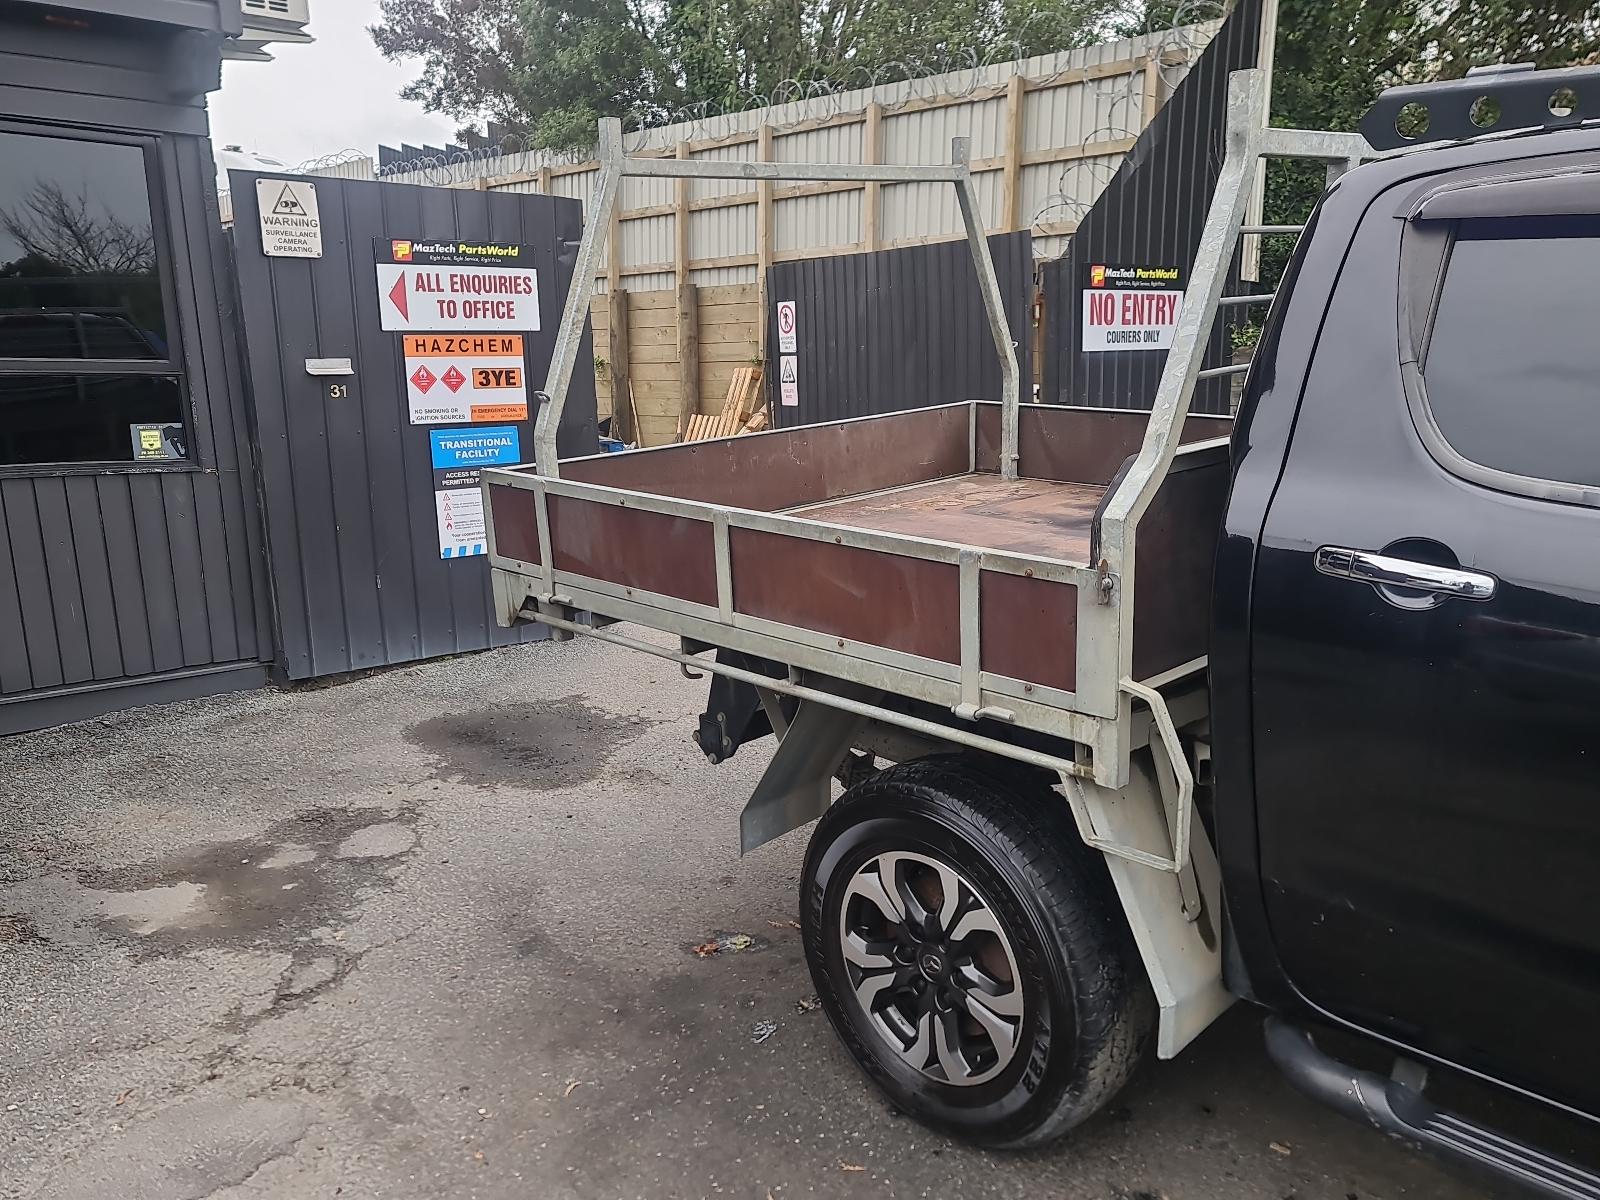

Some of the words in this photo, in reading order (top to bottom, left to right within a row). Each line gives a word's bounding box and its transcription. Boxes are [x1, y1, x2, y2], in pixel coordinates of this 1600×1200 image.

[263, 216, 318, 228] WARNING
[265, 229, 318, 238] SURVEILLANCE
[273, 245, 313, 253] OPERATING
[413, 243, 456, 254] MazTech
[458, 244, 519, 257] PartsWorld
[1105, 268, 1135, 278] MazTech
[1136, 268, 1178, 279] PartsWorld
[415, 272, 444, 292] ALL
[450, 273, 533, 295] ENQUIRIES
[437, 299, 457, 319] TO
[462, 300, 515, 319] OFFICE
[1089, 292, 1115, 326] NO
[1121, 293, 1177, 326] ENTRY
[1106, 330, 1142, 343] COURIERS
[1143, 330, 1160, 343] ONLY
[415, 339, 513, 353] HAZCHEM
[478, 370, 517, 387] 3YE
[330, 384, 347, 398] 31
[440, 437, 513, 450] TRANSITIONAL
[455, 448, 500, 459] FACILITY
[445, 471, 470, 479] ACCESS
[441, 478, 475, 486] PERMITTED
